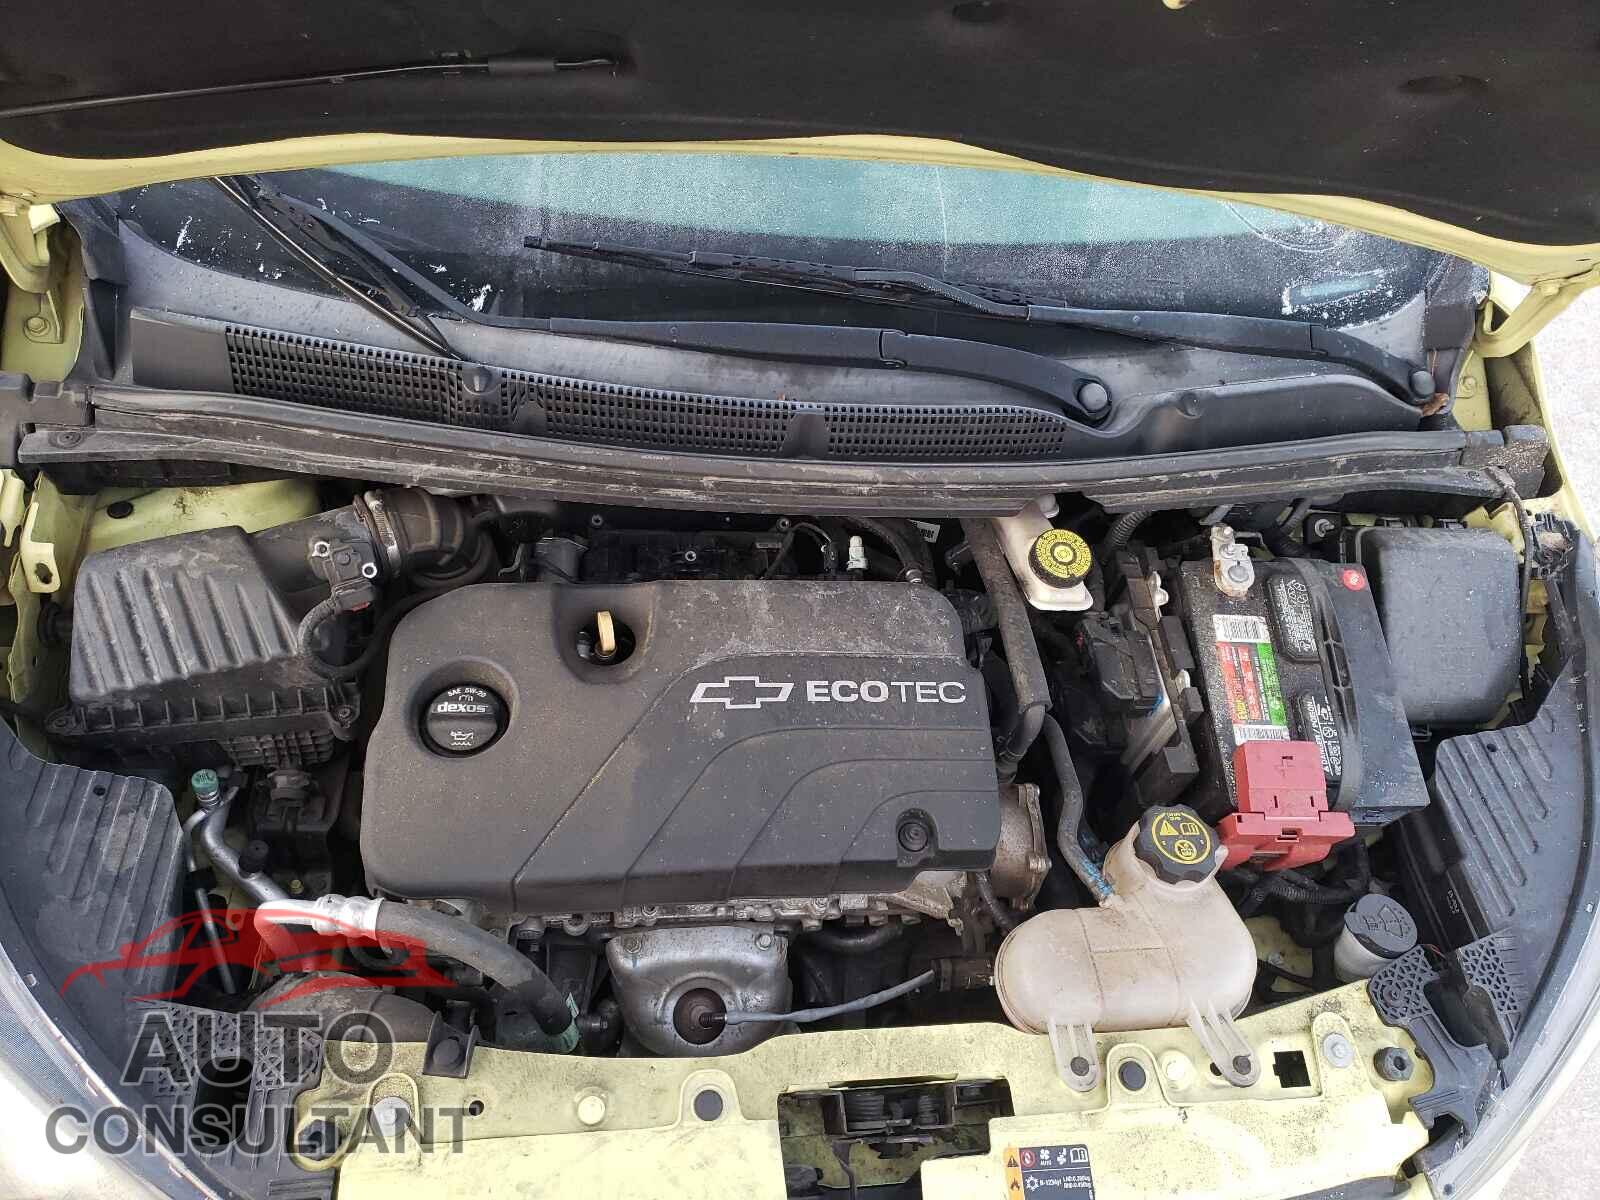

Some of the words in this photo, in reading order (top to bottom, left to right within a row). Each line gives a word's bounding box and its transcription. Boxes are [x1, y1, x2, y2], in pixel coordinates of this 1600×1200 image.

[447, 687, 461, 697] SAE
[464, 687, 487, 698] 5W-20
[806, 680, 966, 703] ECOTEC
[437, 701, 489, 713] dexos
